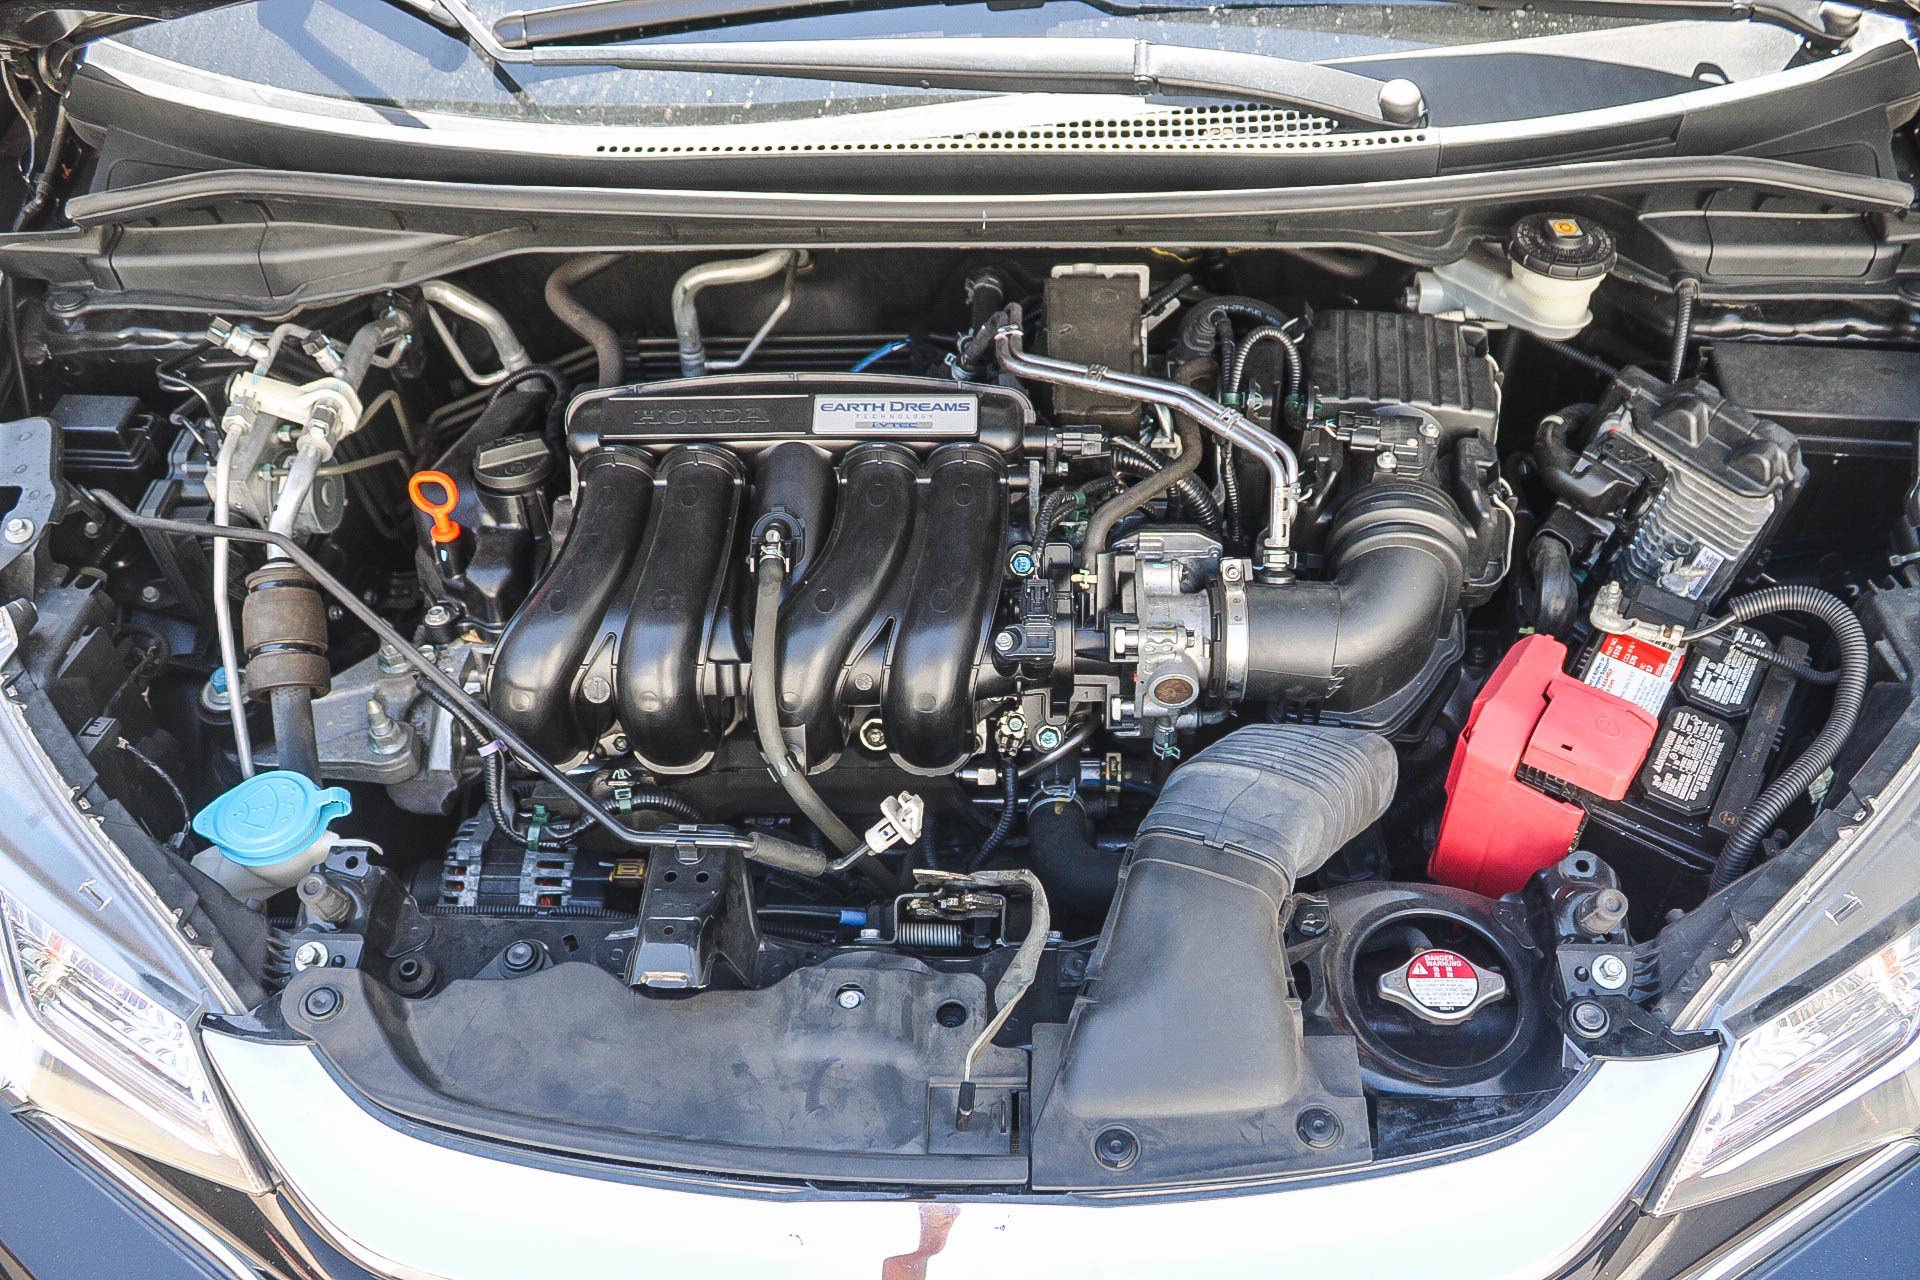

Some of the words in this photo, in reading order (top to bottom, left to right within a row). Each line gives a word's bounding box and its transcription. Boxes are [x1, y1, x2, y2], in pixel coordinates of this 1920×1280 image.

[820, 402, 886, 412] EARTH
[889, 401, 970, 412] DREAMS
[632, 407, 770, 425] HONDA
